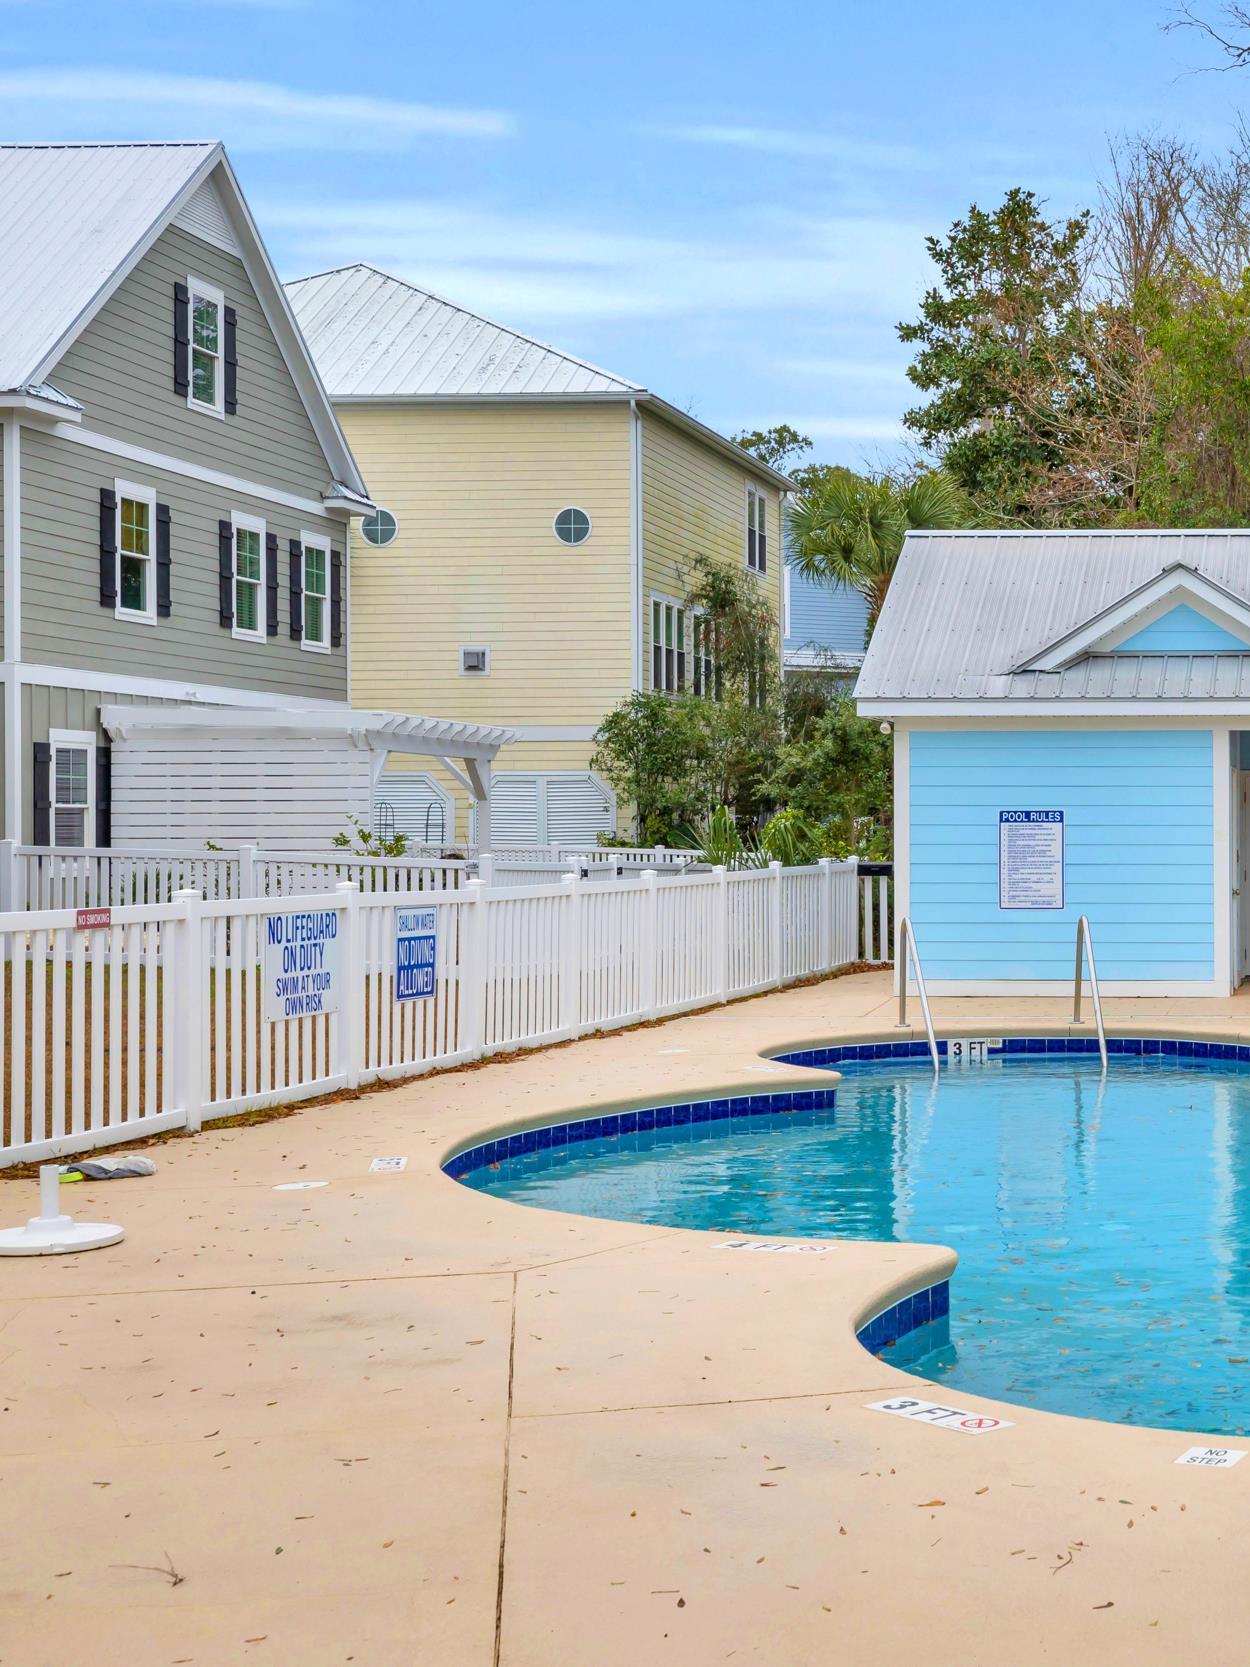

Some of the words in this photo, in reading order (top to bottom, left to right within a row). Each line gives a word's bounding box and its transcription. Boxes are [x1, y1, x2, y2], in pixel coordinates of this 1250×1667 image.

[1002, 812, 1029, 822] POOL
[1030, 812, 1061, 822] RULES
[78, 915, 86, 925] NO
[87, 913, 110, 925] SMOKING
[267, 916, 283, 945] NO
[285, 912, 337, 944] LIFEGUARD
[399, 914, 420, 932] SHALLOW
[420, 913, 435, 931] WATER
[283, 945, 297, 973] ON
[299, 942, 325, 972] DUTY
[399, 941, 409, 967] NO
[410, 938, 434, 965] DIVING
[276, 976, 299, 998] SWIM
[301, 975, 311, 994] AT
[311, 972, 331, 993] YOUR
[400, 966, 433, 995] ALLOWED
[285, 996, 304, 1016] OWN
[305, 993, 323, 1013] RISK
[953, 1042, 963, 1056] 3
[969, 1041, 985, 1056] FT
[753, 1243, 791, 1251] FT
[882, 1400, 919, 1410] 3
[910, 1407, 967, 1421] FT
[1186, 1456, 1228, 1465] STEP
[1204, 1449, 1228, 1457] NO
